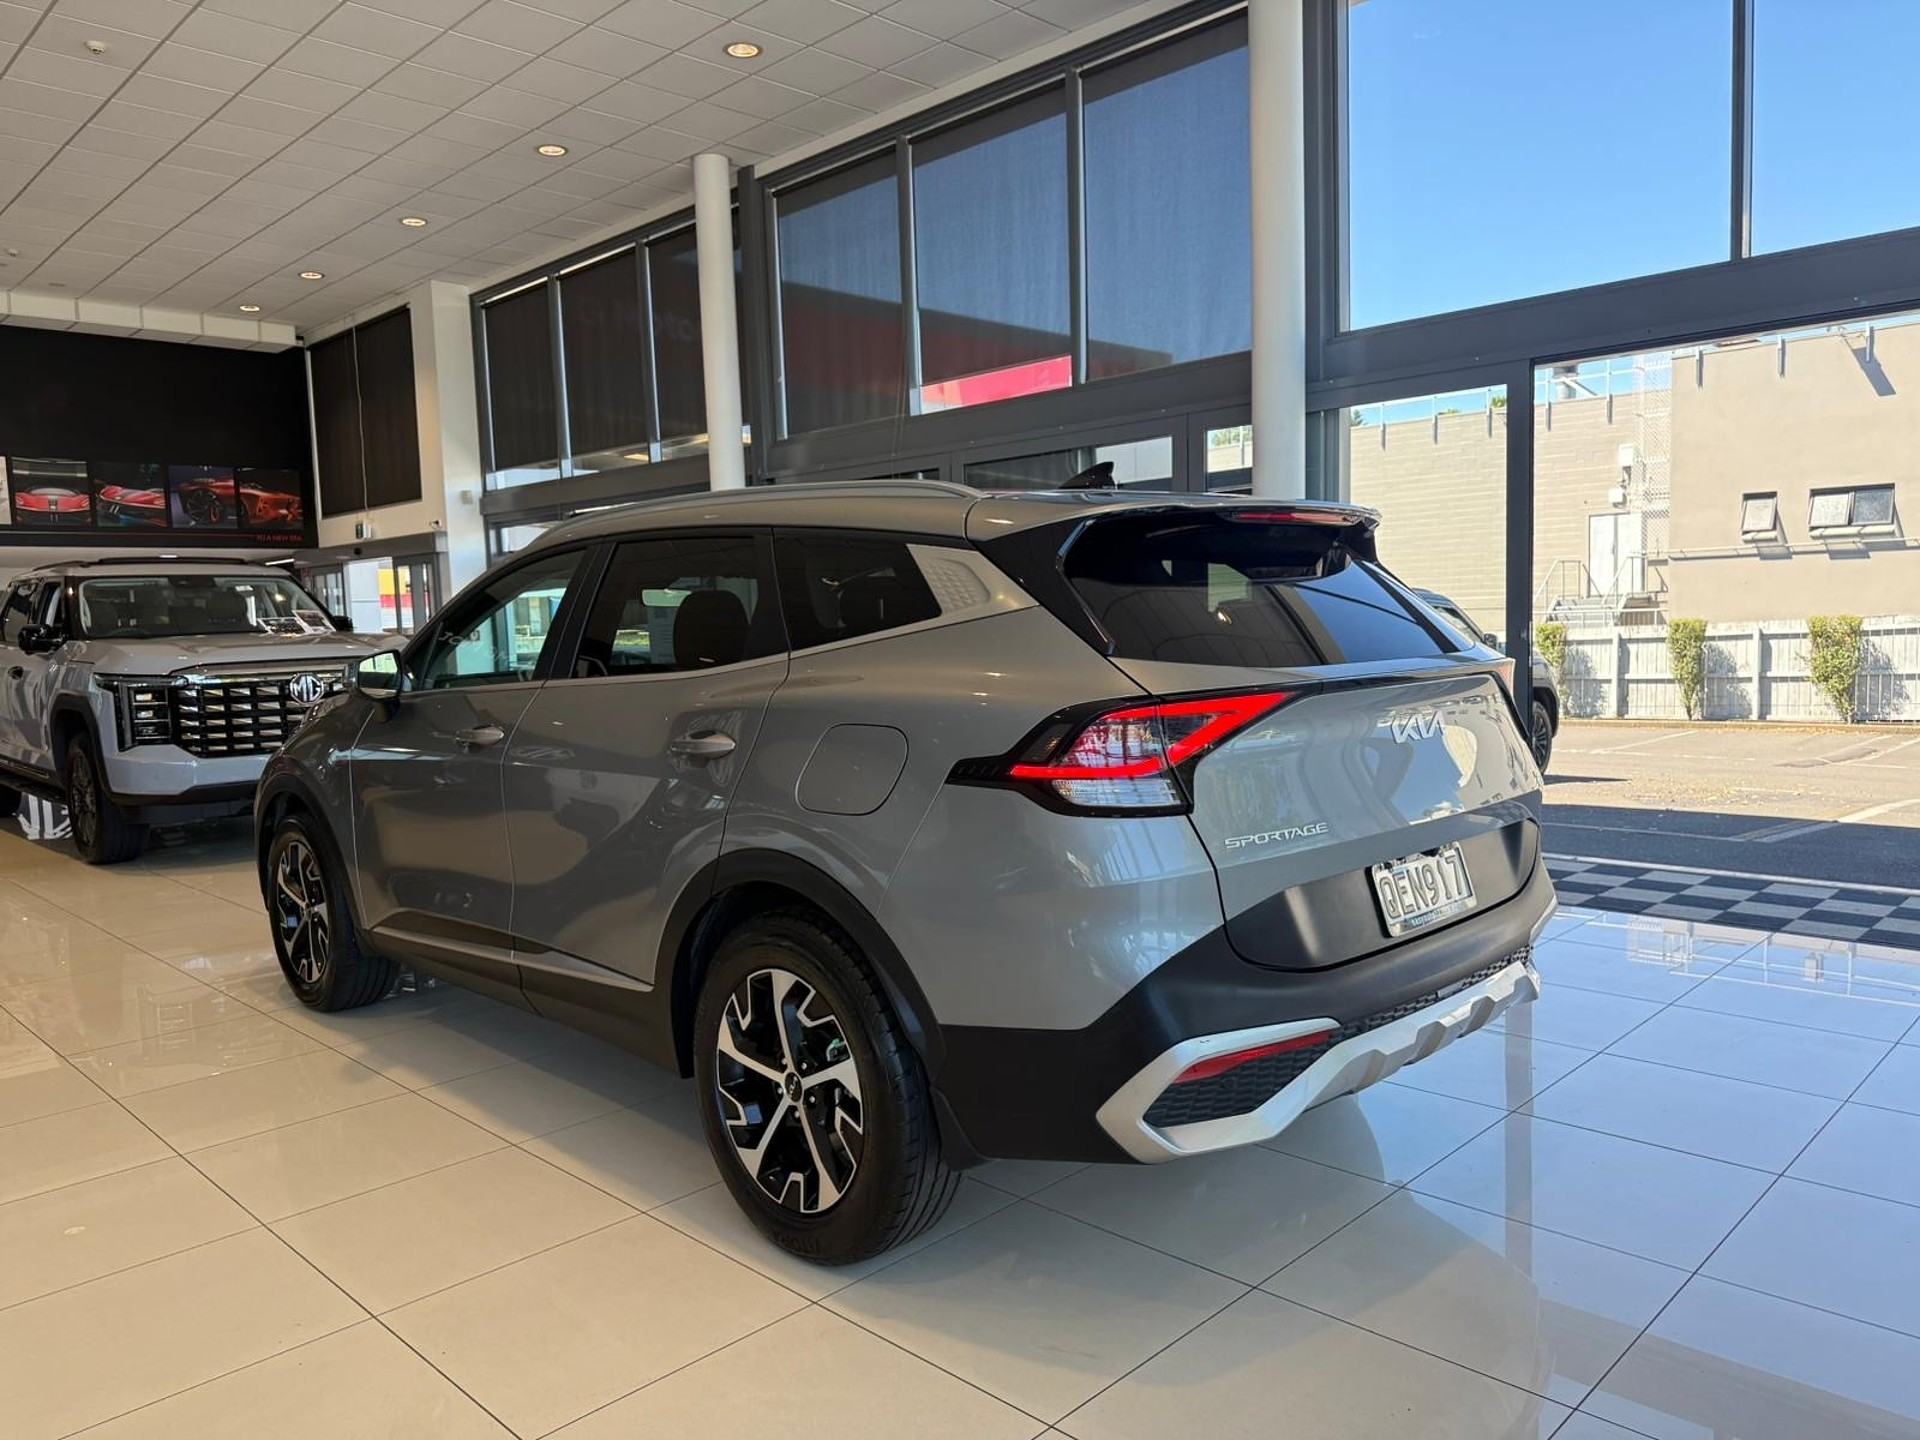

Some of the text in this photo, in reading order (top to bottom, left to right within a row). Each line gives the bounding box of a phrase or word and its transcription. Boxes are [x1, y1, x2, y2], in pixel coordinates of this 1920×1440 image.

[293, 675, 321, 702] MG
[1391, 710, 1444, 744] KIA
[1224, 822, 1329, 849] SPORTAGE
[1379, 854, 1463, 920] QEN917
